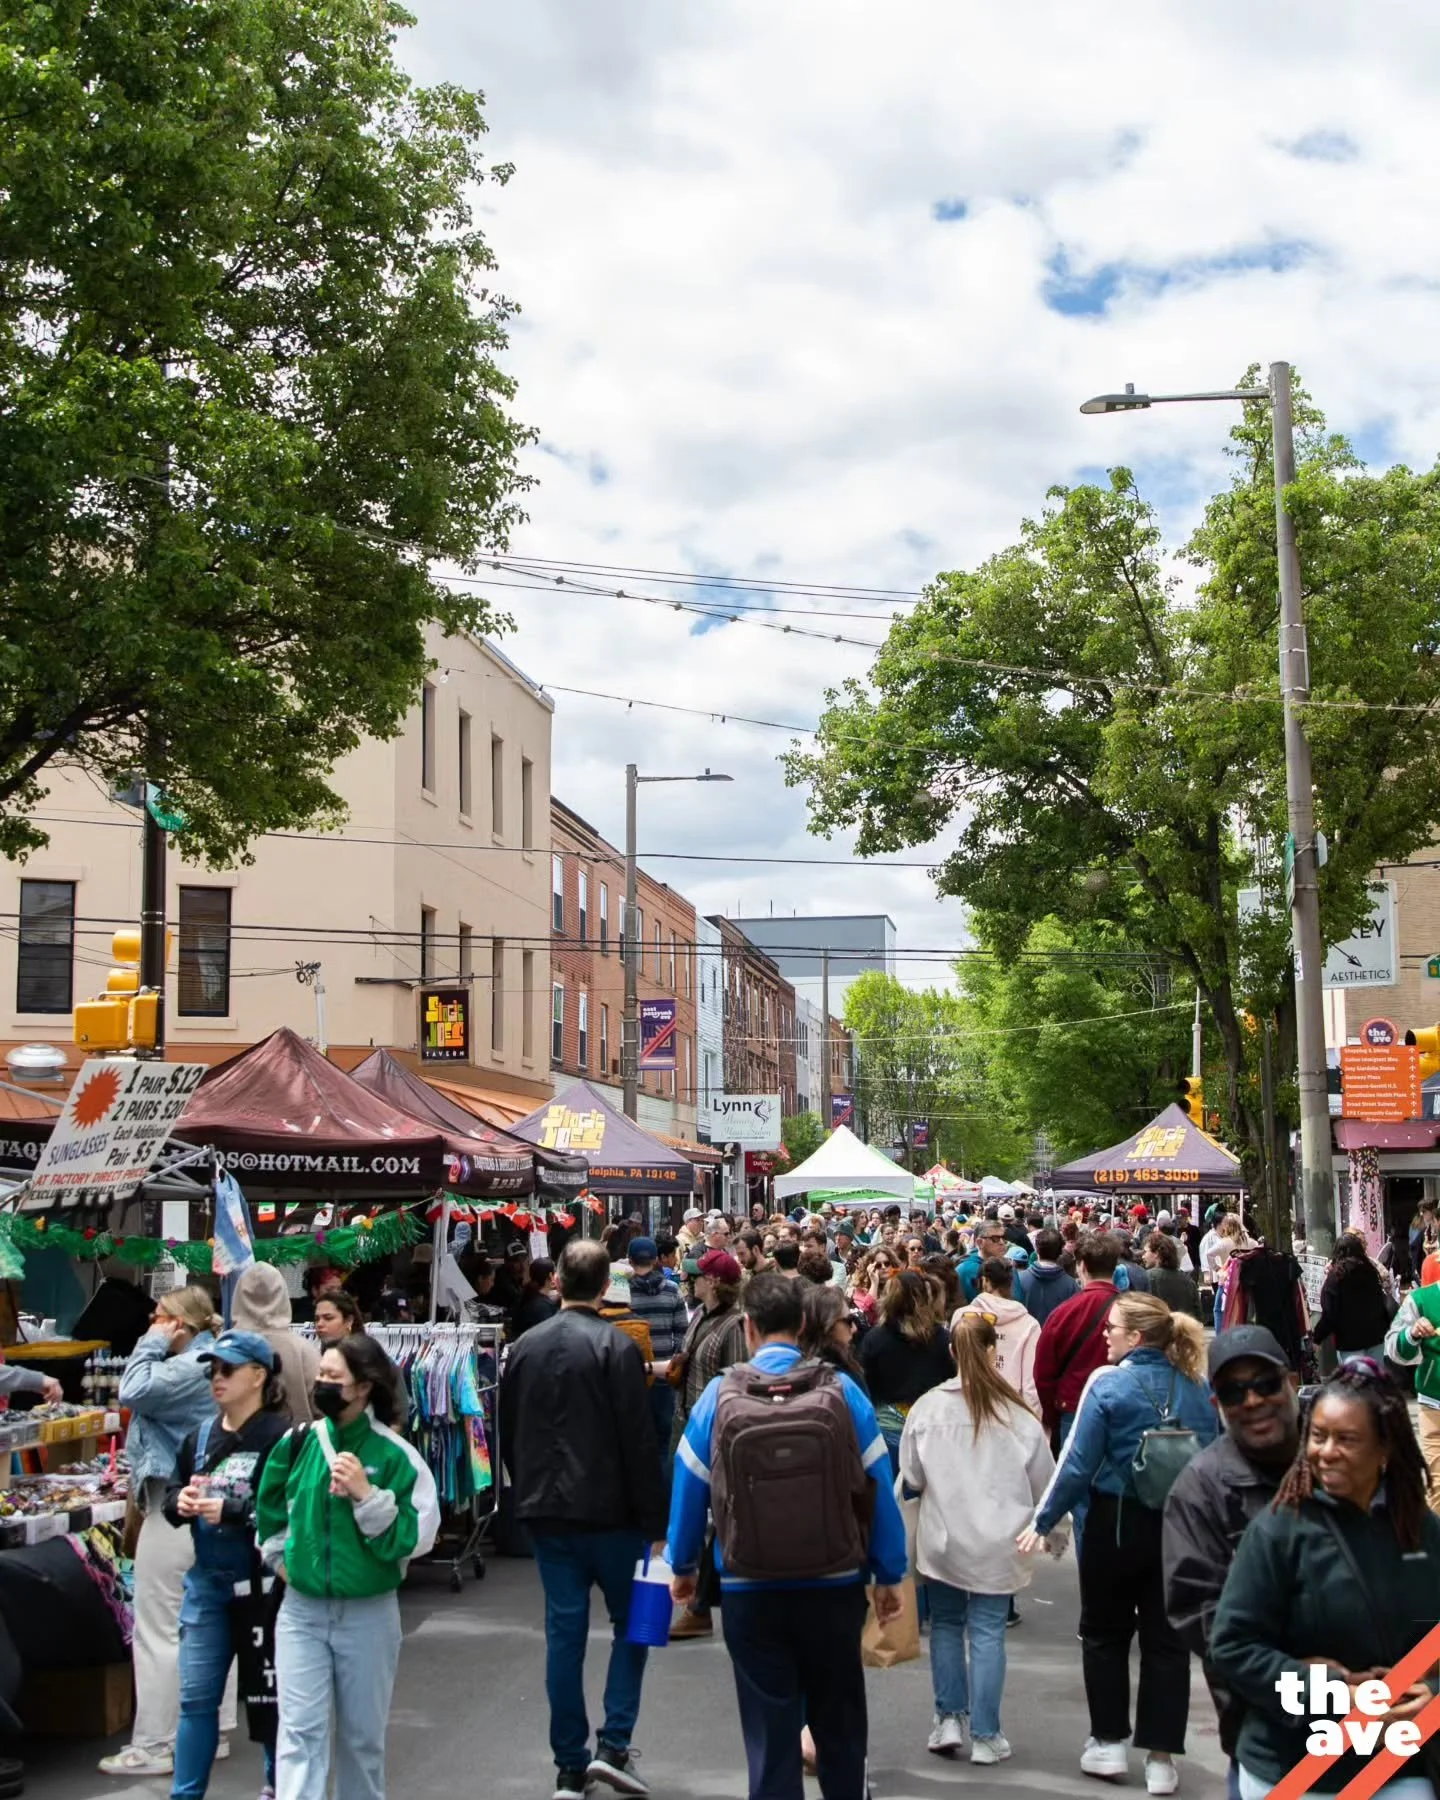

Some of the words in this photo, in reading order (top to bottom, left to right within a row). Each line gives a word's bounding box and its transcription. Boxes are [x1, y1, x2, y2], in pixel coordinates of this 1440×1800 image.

[1330, 969, 1391, 982] AESTHETICS
[1368, 1028, 1386, 1037] the
[124, 1064, 142, 1094] 1
[136, 1076, 167, 1094] PAIR
[165, 1065, 203, 1097] $12
[111, 1101, 125, 1121] 2
[123, 1100, 163, 1121] PAIRS
[160, 1100, 186, 1121] $20
[713, 1098, 752, 1115] Lynn
[113, 1125, 133, 1140] Each
[47, 1132, 110, 1167] SUNGLASSES
[105, 1147, 131, 1167] Pair
[132, 1140, 156, 1165] $5
[50, 1172, 91, 1185] FACTORY
[92, 1170, 121, 1183] DIRECT
[630, 1168, 643, 1179] PA
[1093, 1168, 1130, 1184] (215)
[1133, 1167, 1199, 1182] 463-3030
